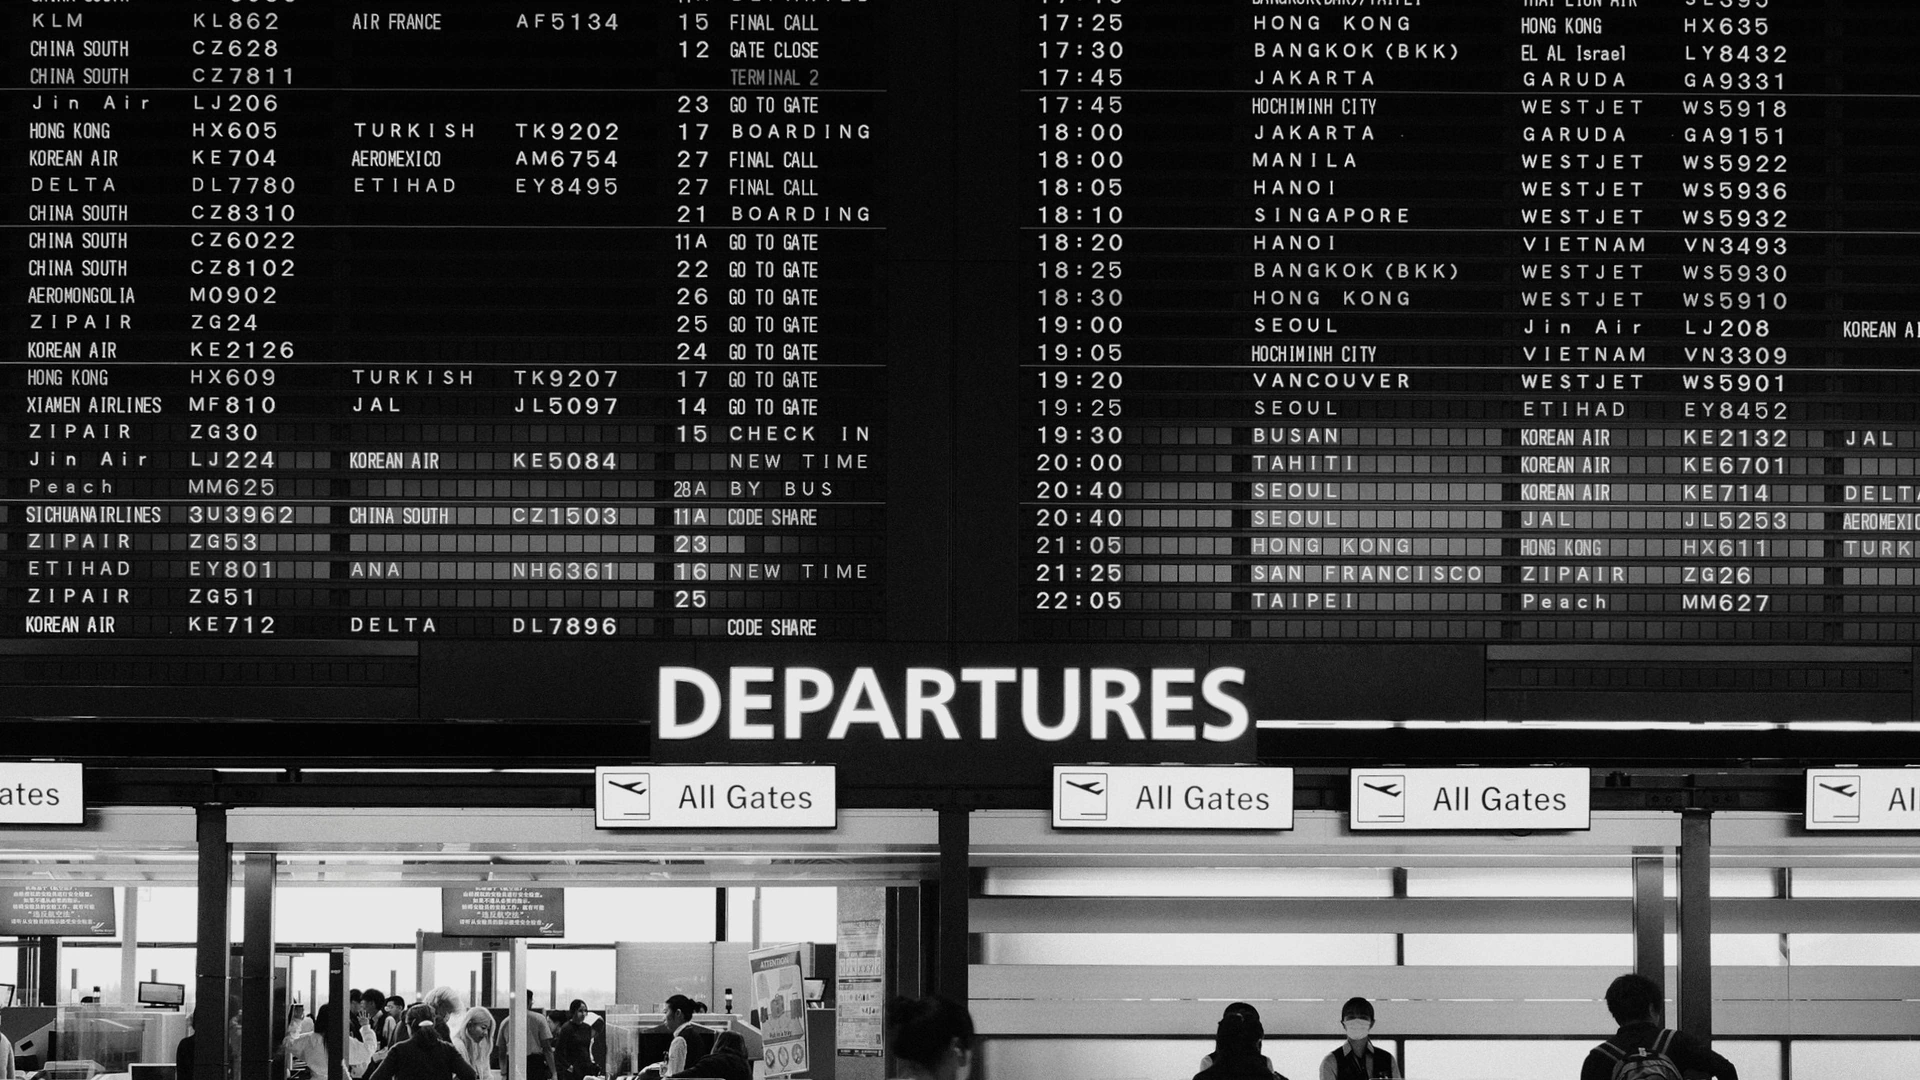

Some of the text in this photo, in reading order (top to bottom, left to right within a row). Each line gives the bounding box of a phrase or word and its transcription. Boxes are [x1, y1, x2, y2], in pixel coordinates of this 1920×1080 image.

[32, 12, 83, 28] KLM
[352, 12, 442, 31] AIR FRANCE
[516, 12, 619, 31] AF5134
[678, 13, 709, 31] 15
[1038, 13, 1123, 32] 17:25
[1521, 16, 1602, 35] HONG KONG
[192, 39, 278, 58] CZ628
[729, 41, 819, 59] GATE CLOSE
[1685, 44, 1787, 63] LY8432
[30, 67, 129, 85] CHINA SOUTH
[1038, 68, 1123, 87] 17:45
[1523, 71, 1626, 87] GARUDA
[194, 94, 278, 112] LJ206
[729, 96, 819, 114] GO TO GATE
[1251, 97, 1377, 115] HOCHIMINH CITY
[1682, 99, 1787, 118] WS5918
[29, 121, 111, 140] HONG KONG
[353, 122, 474, 138] TURKISH
[515, 122, 619, 141] TK9202
[678, 122, 709, 141] 17
[1038, 123, 1123, 142] 18:00
[1523, 126, 1626, 142] GARUDA
[192, 148, 277, 167] KE704
[515, 149, 618, 168] AM6754
[729, 150, 819, 169] FINAL CALL
[1252, 152, 1357, 168] MANILA
[1521, 153, 1643, 170] WESTJET
[1682, 154, 1787, 173] WS5922
[31, 176, 116, 192] DELTA
[354, 177, 456, 193] ETIHAD
[516, 177, 618, 196] EY8495
[677, 177, 709, 196] 27
[1038, 178, 1123, 197] 18:05
[1521, 181, 1644, 197] WESTJET
[191, 204, 295, 222] CZ8310
[731, 205, 870, 222] BOARDING
[1254, 207, 1409, 224] SINGAPORE
[1521, 208, 1643, 225] WESTJET
[1682, 209, 1787, 228] WS5932
[28, 231, 128, 249] CHINA SOUTH
[1038, 233, 1123, 252] 18:20
[1522, 236, 1645, 252] VIETNAM
[190, 258, 295, 277] CZ8102
[677, 259, 709, 278] 22
[728, 260, 819, 279] GO TO GATE
[1038, 261, 1122, 279] 18:25
[1682, 264, 1787, 283] WS5930
[27, 286, 135, 304] AEROMONGOLIA
[676, 287, 709, 306] 26
[1038, 288, 1123, 307] 18:30
[1521, 291, 1644, 307] WESTJET
[191, 313, 258, 332] ZG24
[728, 315, 819, 334] GO TO GATE
[1254, 317, 1338, 333] SEOUL
[1685, 319, 1770, 338] LJ208
[27, 341, 117, 359] KOREAN AIR
[676, 342, 708, 361] 24
[1038, 343, 1122, 362] 19:05
[1522, 346, 1645, 362] VIETNAM
[190, 368, 275, 387] HX609
[513, 369, 618, 388] TK9207
[728, 370, 818, 389] GO TO GATE
[1252, 372, 1410, 389] VANCOUVER
[1682, 374, 1783, 393] WS5901
[26, 396, 162, 414] XIAMEN AIRLINES
[352, 396, 401, 413] JAL
[514, 396, 618, 415] JL5097
[677, 397, 707, 416] 14
[1038, 398, 1122, 417] 19:25
[1523, 401, 1625, 417] ETIHAD
[190, 423, 258, 442] ZG30
[729, 425, 869, 442] CHECK IN
[1253, 427, 1338, 443] BUSAN
[1684, 428, 1787, 448] KE2132
[1845, 430, 1893, 446] JAL
[29, 451, 147, 467] Jin Air
[349, 451, 440, 470] KOREAN AIR
[513, 451, 617, 470] KE5084
[1036, 453, 1122, 472] 20:00
[1521, 455, 1611, 474] KOREAN AIR
[188, 478, 275, 496] MM625
[730, 480, 832, 497] BY BUS
[1254, 482, 1338, 498] SEOUL
[1684, 483, 1769, 503] KE714
[1845, 485, 1920, 501] DELT
[25, 505, 162, 524] SICHUANAIRLINES
[349, 506, 449, 525] CHINA SOUTH
[512, 506, 617, 525] CZ1503
[1036, 508, 1122, 527] 20:40
[1523, 511, 1571, 527] JAL
[189, 533, 257, 551] ZG53
[1252, 537, 1409, 554] HONG KONG
[1683, 538, 1765, 558] HX611
[28, 560, 130, 576] ETIHAD
[350, 561, 400, 577] ANA
[513, 561, 613, 580] NH6361
[676, 562, 707, 581] 16
[1036, 563, 1122, 582] 21:25
[1522, 566, 1624, 582] ZIPAIR
[189, 588, 253, 606] ZG51
[1252, 592, 1352, 609] TAIPEI
[1682, 593, 1769, 612] MM627
[25, 615, 115, 634] KOREAN AIR
[350, 616, 436, 633] DELTA
[512, 617, 617, 636] DL7896
[657, 666, 1250, 742] DEPARTURES
[678, 784, 812, 810] All Gates
[1136, 785, 1270, 811] All Gates
[1433, 786, 1567, 812] All Gates
[1888, 787, 1920, 812] Al
[760, 956, 790, 969] ATTENTION
